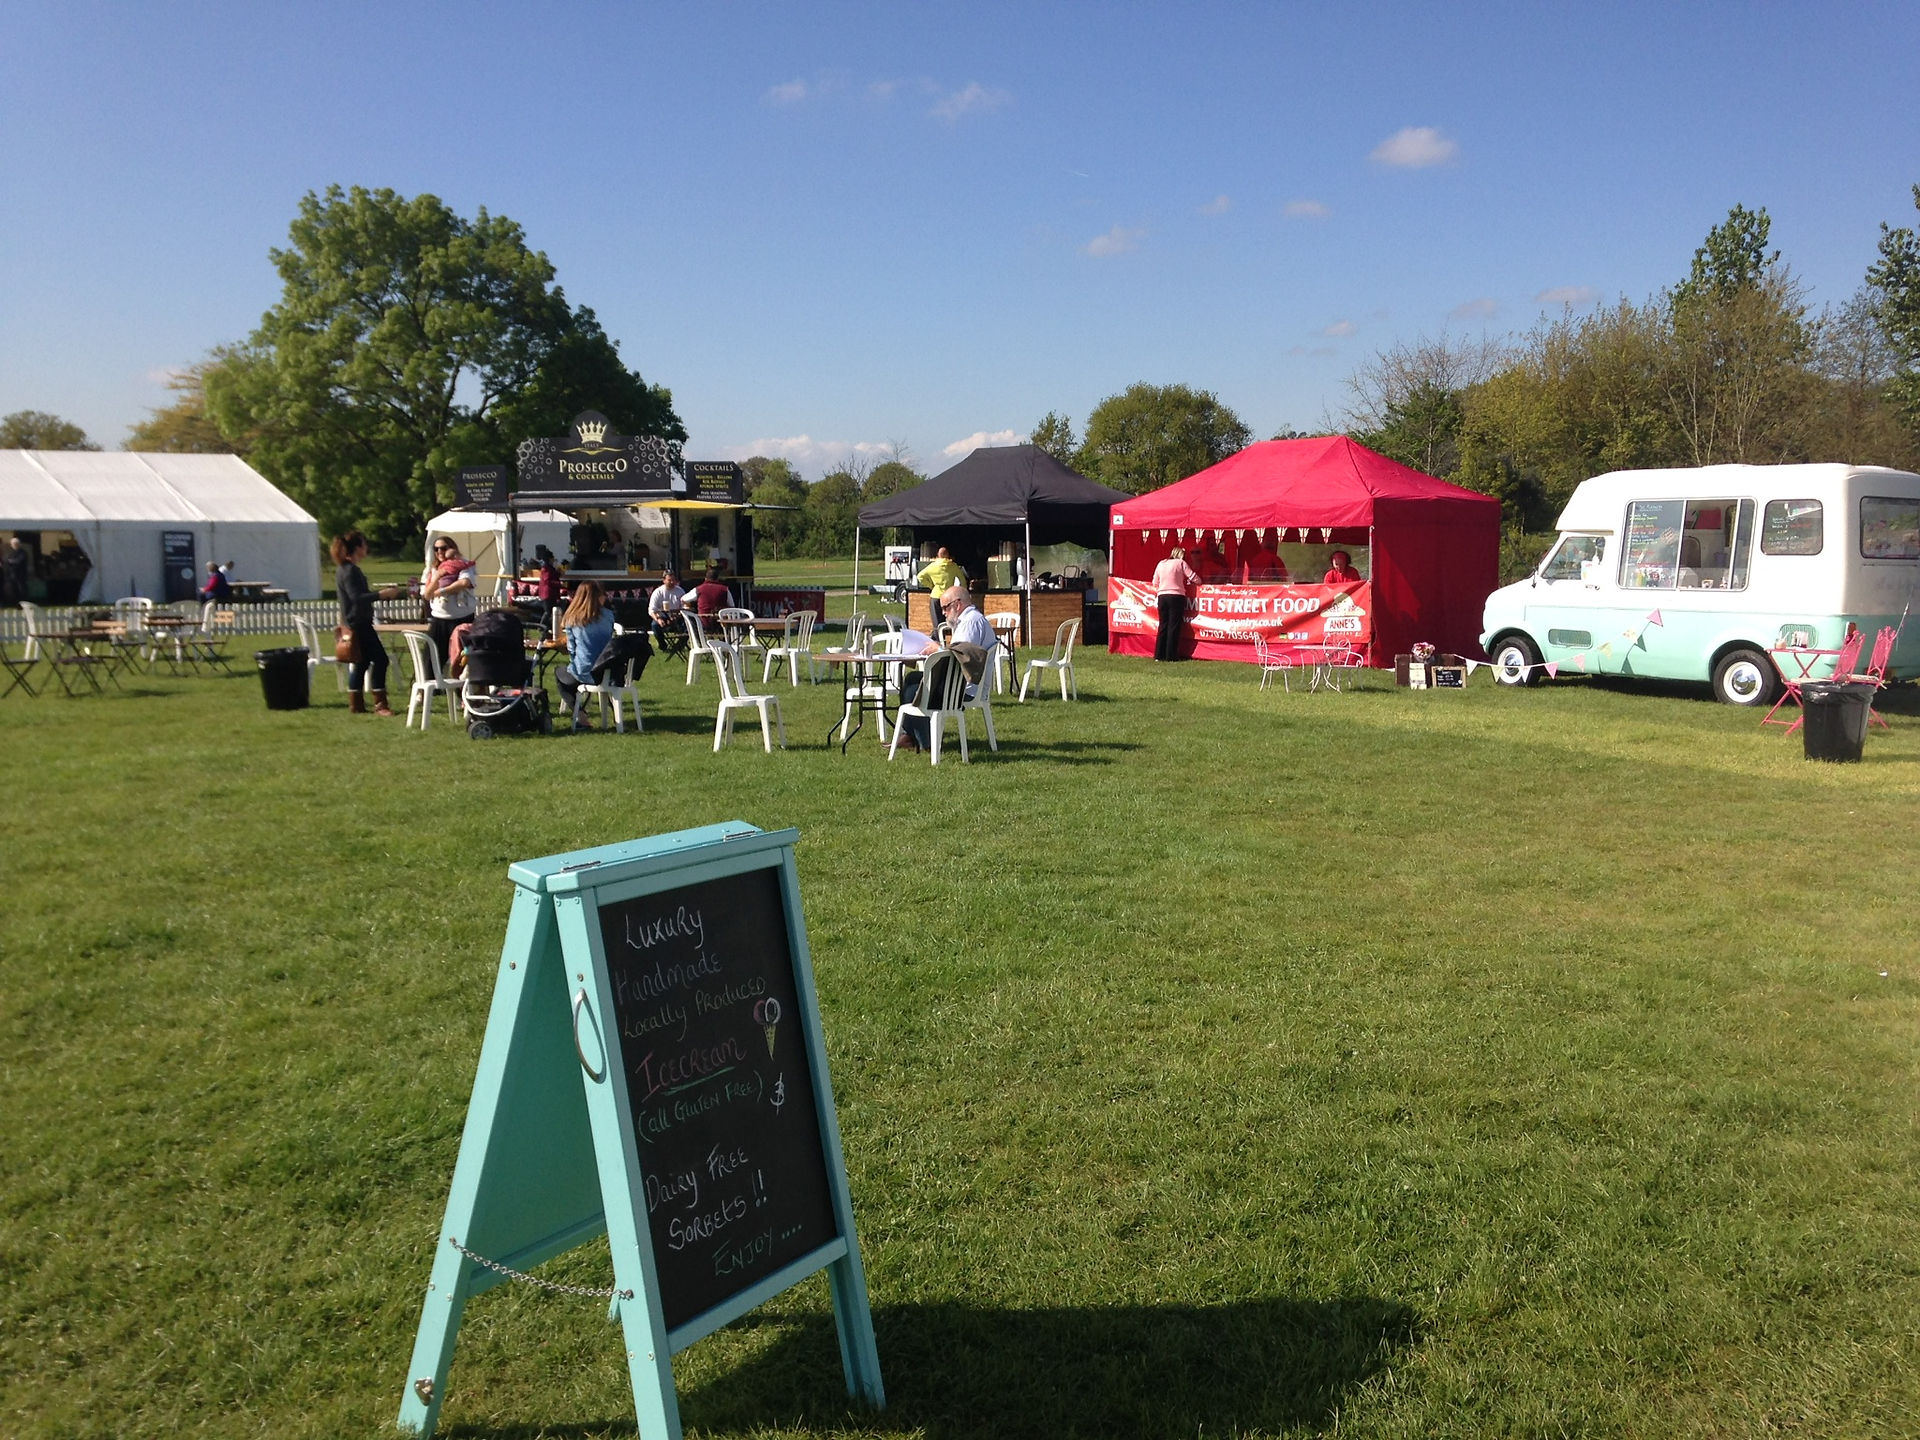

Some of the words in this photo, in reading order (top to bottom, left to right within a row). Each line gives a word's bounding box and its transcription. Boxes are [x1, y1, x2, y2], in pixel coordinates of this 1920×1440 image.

[559, 458, 627, 473] PROSECCO
[693, 463, 734, 472] COCKTAILS
[462, 471, 497, 480] PROSECCO
[1217, 597, 1269, 613] STREET
[1273, 597, 1320, 613] FOOD
[1117, 611, 1137, 621] ANNE'S
[1329, 618, 1355, 629] ANNE'S
[1200, 628, 1225, 639] 07702
[712, 1225, 773, 1276] ENJOY
